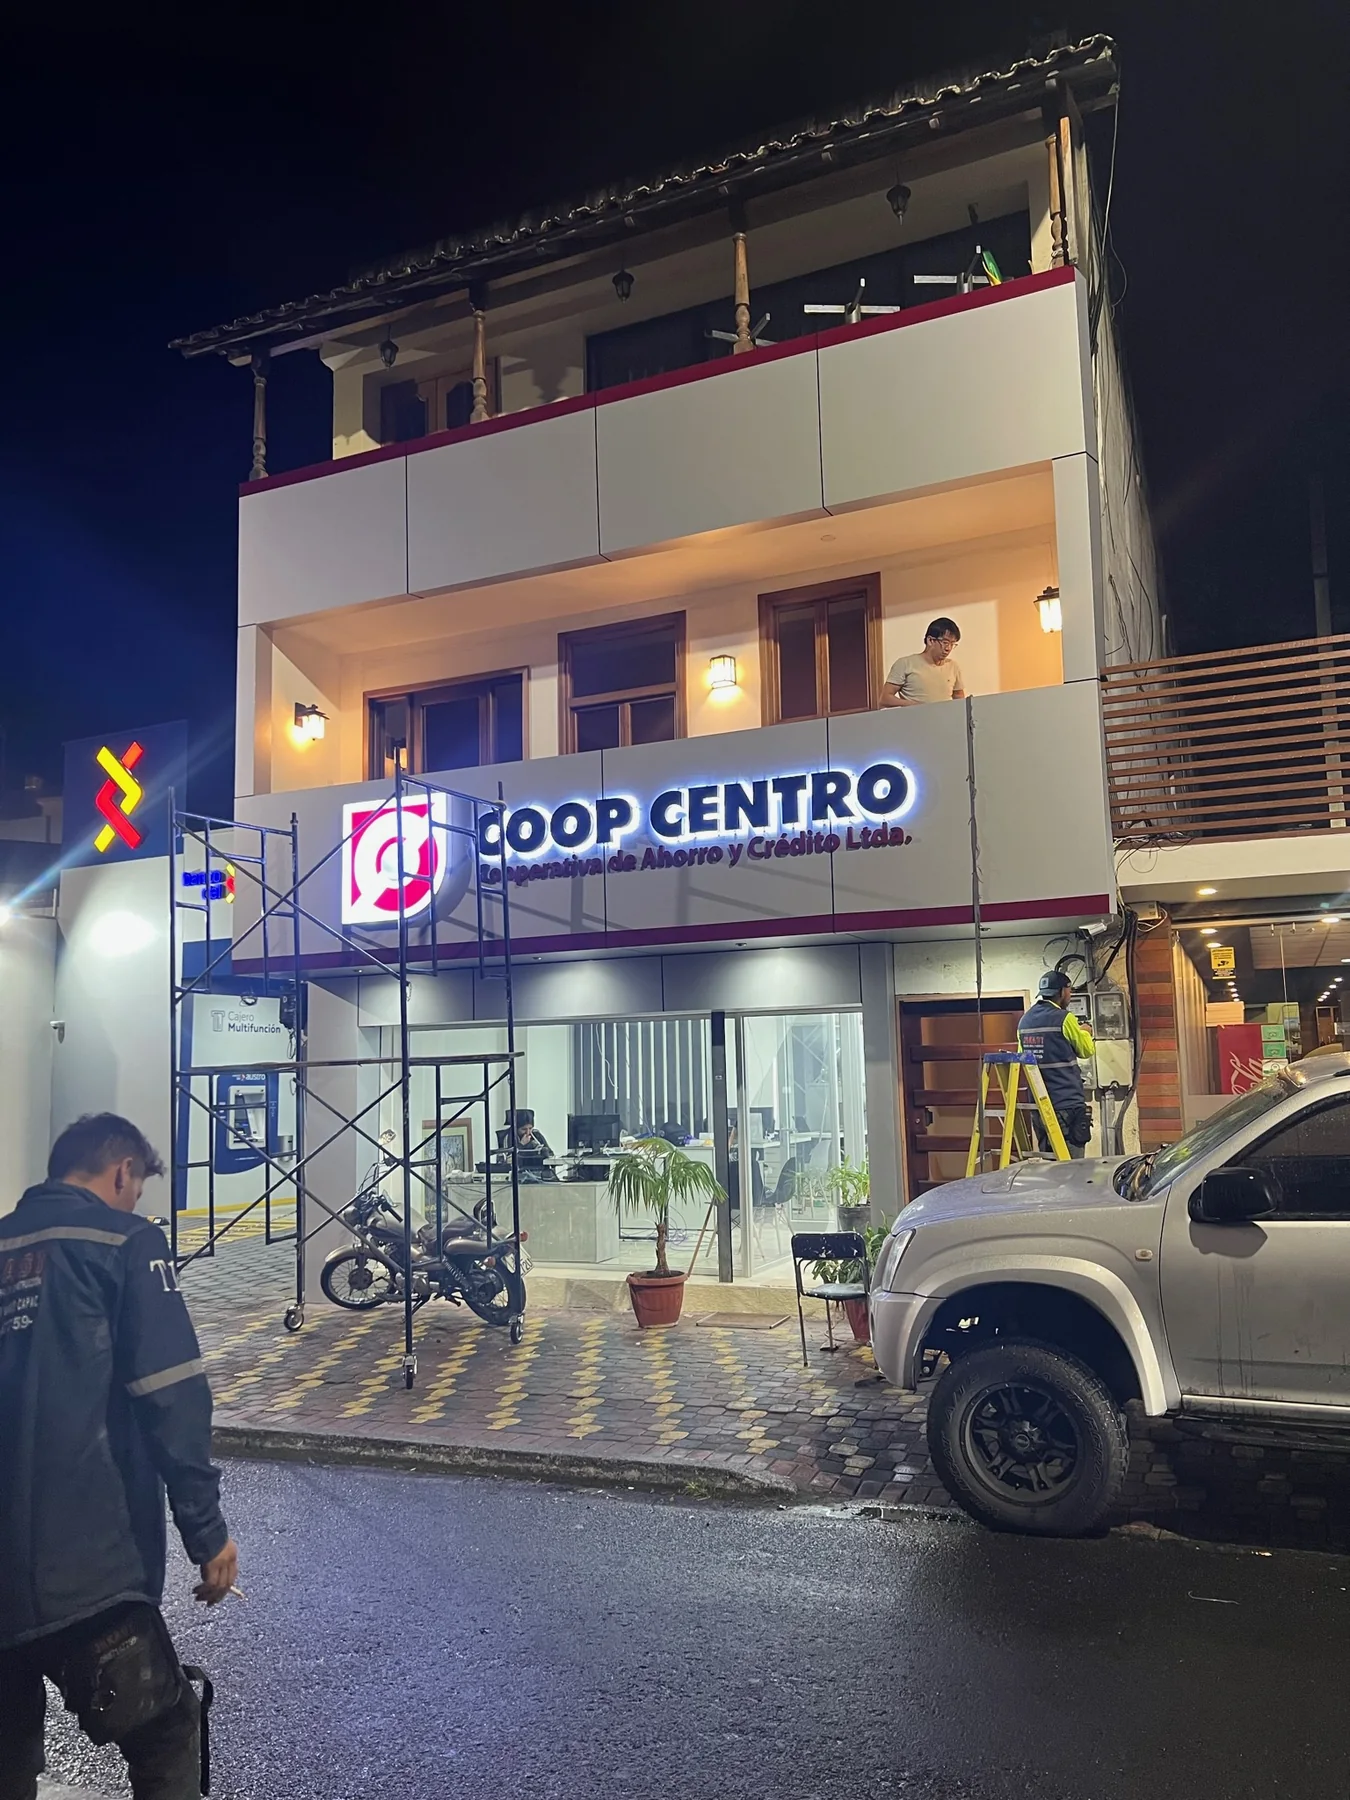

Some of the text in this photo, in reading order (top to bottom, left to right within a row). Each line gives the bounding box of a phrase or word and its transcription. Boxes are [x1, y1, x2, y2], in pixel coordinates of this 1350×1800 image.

[478, 763, 909, 857] COOP CENTRO
[607, 850, 637, 872] de
[641, 843, 724, 871] Ahorro
[728, 843, 744, 868] y
[748, 830, 841, 860] Crédito
[227, 1010, 255, 1023] Cajero
[227, 1022, 281, 1034] Multifunción
